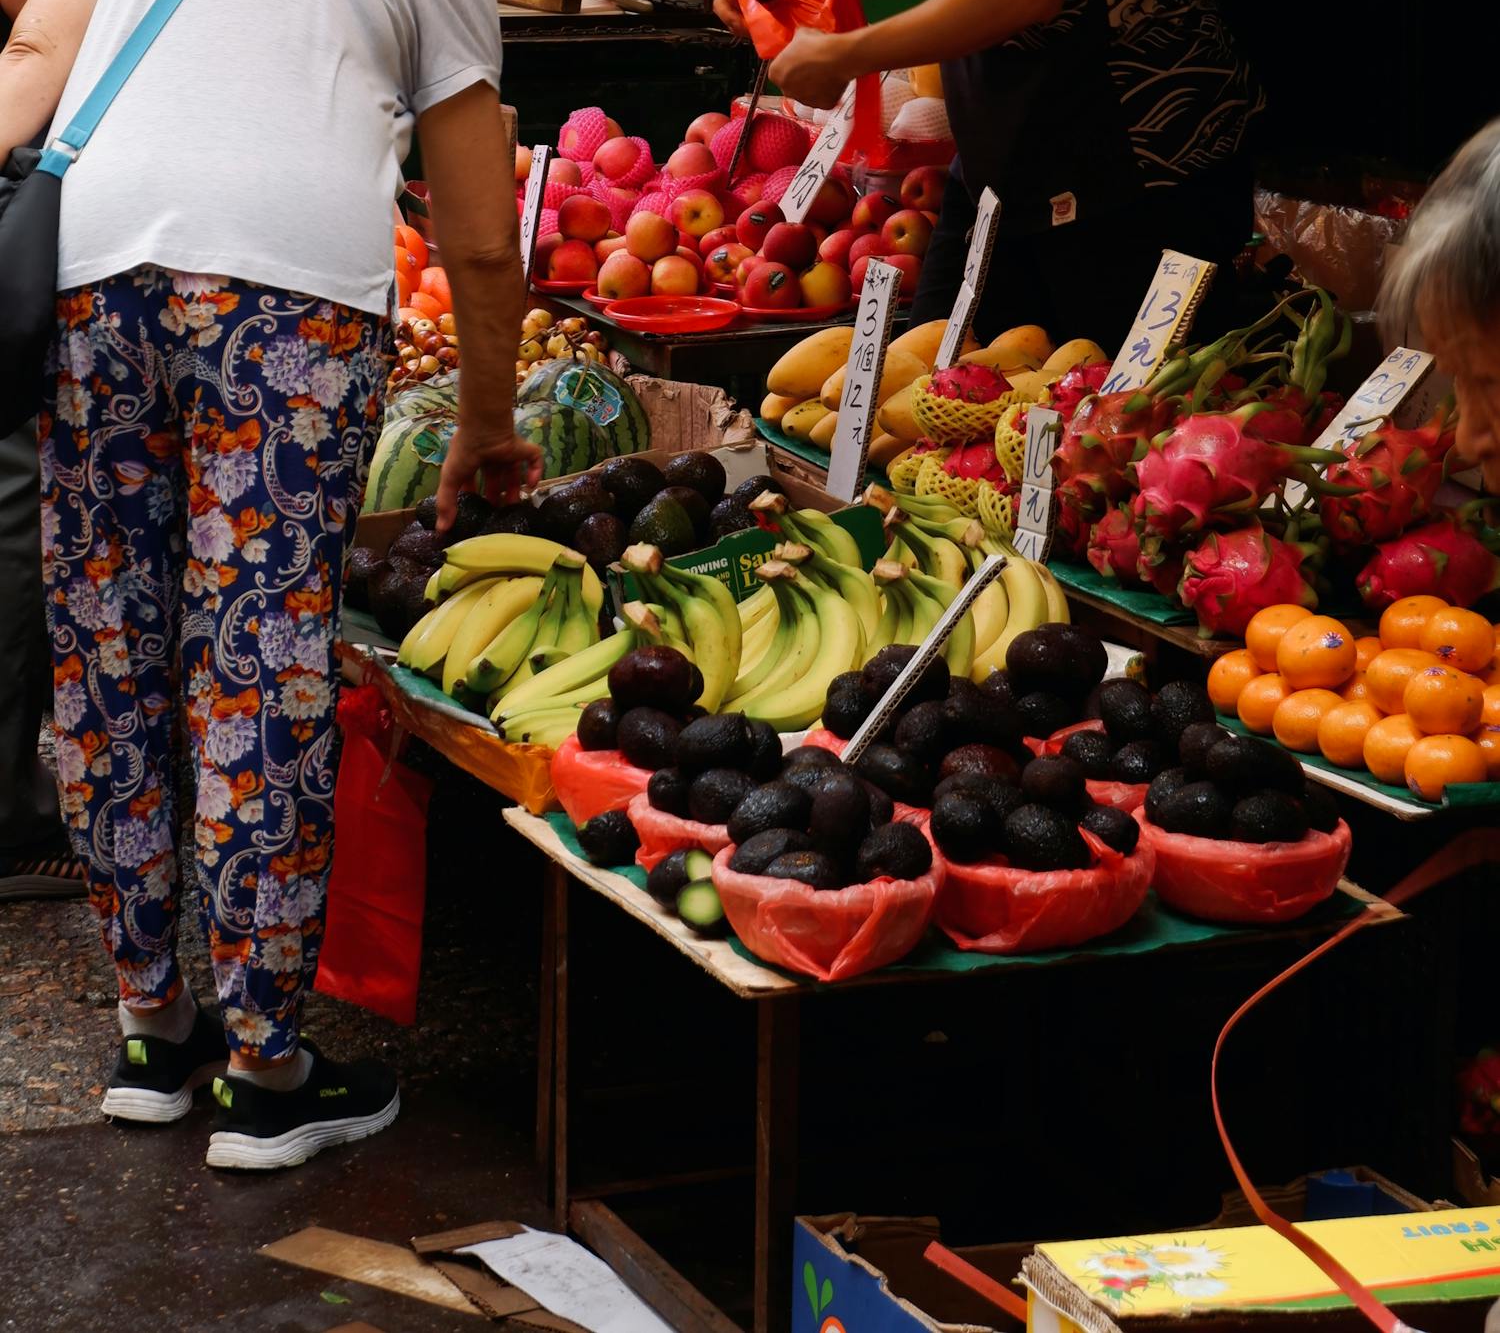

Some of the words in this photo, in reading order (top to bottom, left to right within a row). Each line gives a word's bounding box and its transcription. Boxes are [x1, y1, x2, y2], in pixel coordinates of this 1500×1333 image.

[1140, 288, 1182, 330] 13
[1357, 371, 1407, 405] 20
[1401, 1220, 1490, 1238] FRUIT
